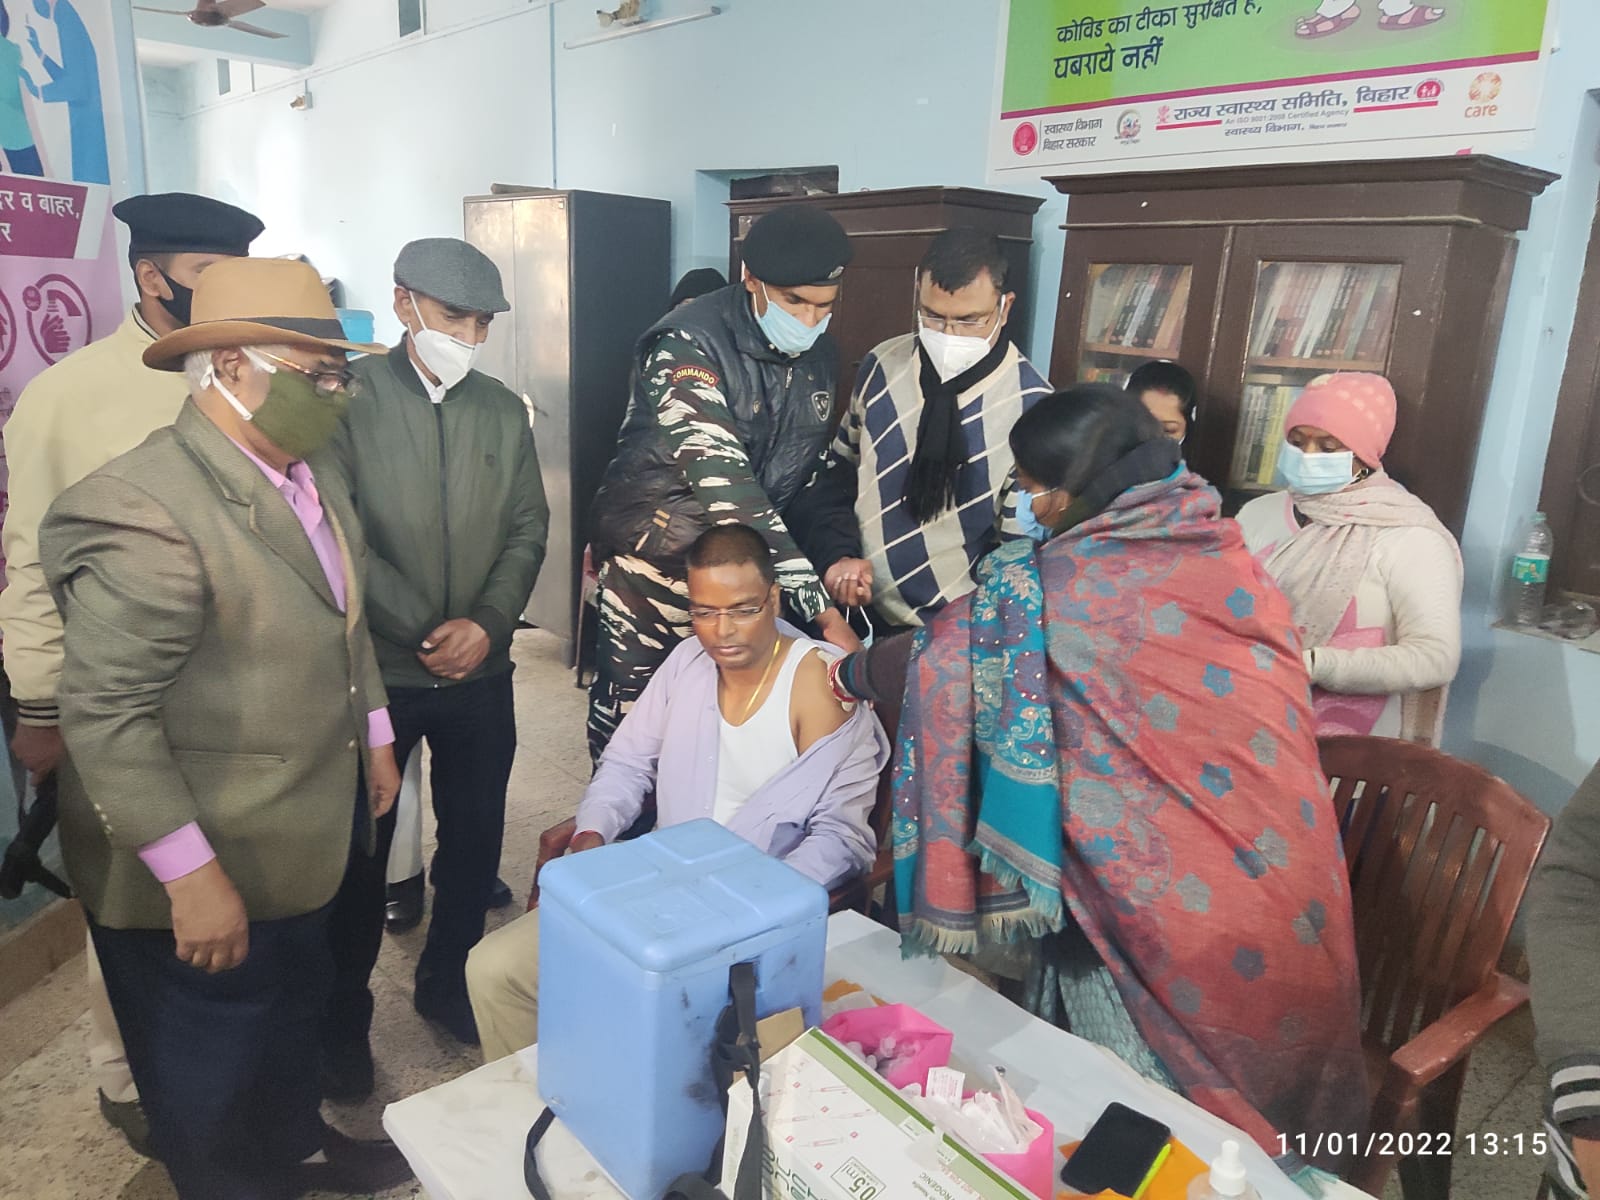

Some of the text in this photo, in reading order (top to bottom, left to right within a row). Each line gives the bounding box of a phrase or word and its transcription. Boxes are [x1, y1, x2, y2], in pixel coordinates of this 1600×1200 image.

[1056, 16, 1105, 43] कोविड
[1108, 14, 1133, 35] का
[1136, 6, 1179, 31] टीका
[1121, 36, 1164, 70] नहीं
[1173, 104, 1210, 121] राज्य
[1216, 98, 1278, 117] स्वास्थ्य
[1282, 89, 1348, 111] समिति,
[1355, 85, 1412, 104] बिहार
[1464, 103, 1499, 119] care
[0, 190, 15, 211] र
[37, 193, 80, 220] बाहर,
[672, 367, 715, 385] COMMANDO
[919, 1171, 956, 1200] ROGENIC
